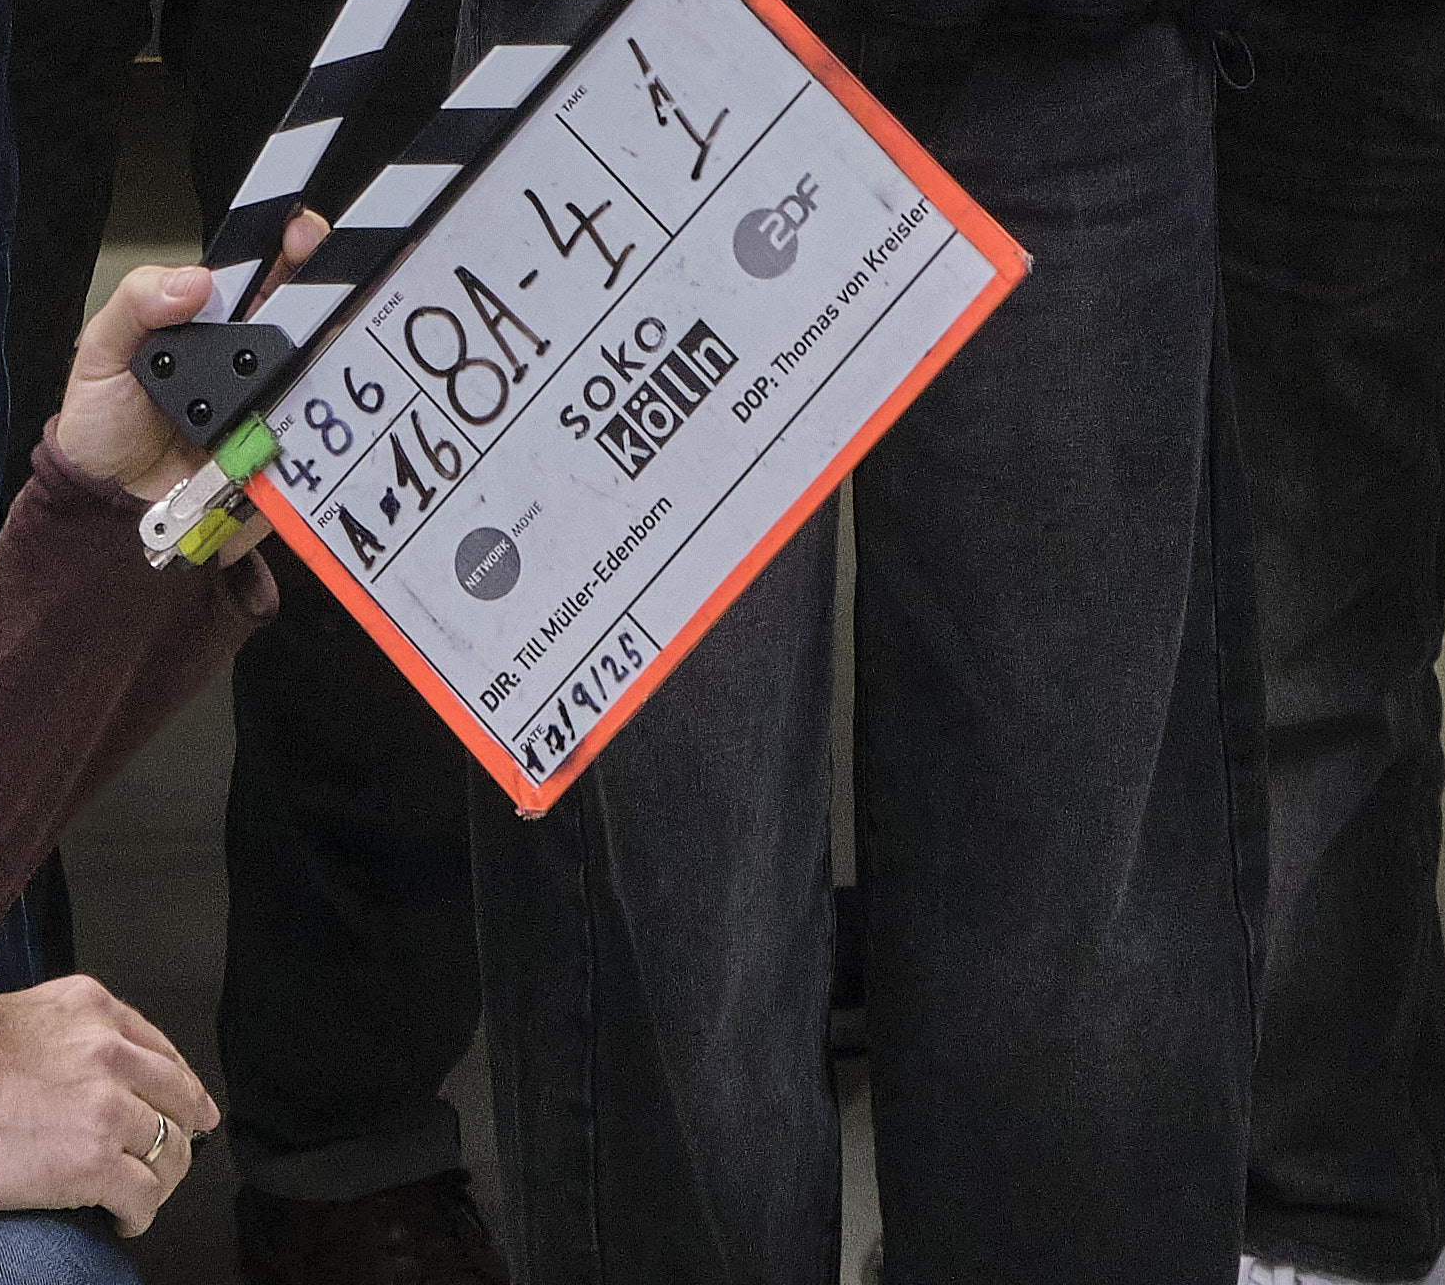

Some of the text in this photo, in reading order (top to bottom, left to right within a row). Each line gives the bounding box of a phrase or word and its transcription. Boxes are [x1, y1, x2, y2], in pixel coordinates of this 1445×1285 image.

[562, 85, 588, 114] TAKE
[759, 172, 819, 252] ZDF
[372, 291, 404, 328] SCENE
[731, 375, 780, 425] DOP:
[770, 304, 840, 376] Thomas
[836, 271, 870, 306] von
[316, 501, 344, 529] ROLL
[465, 500, 544, 590] NETWORK MOVIE
[479, 495, 674, 713] DIR: Till Müller-Edenborn
